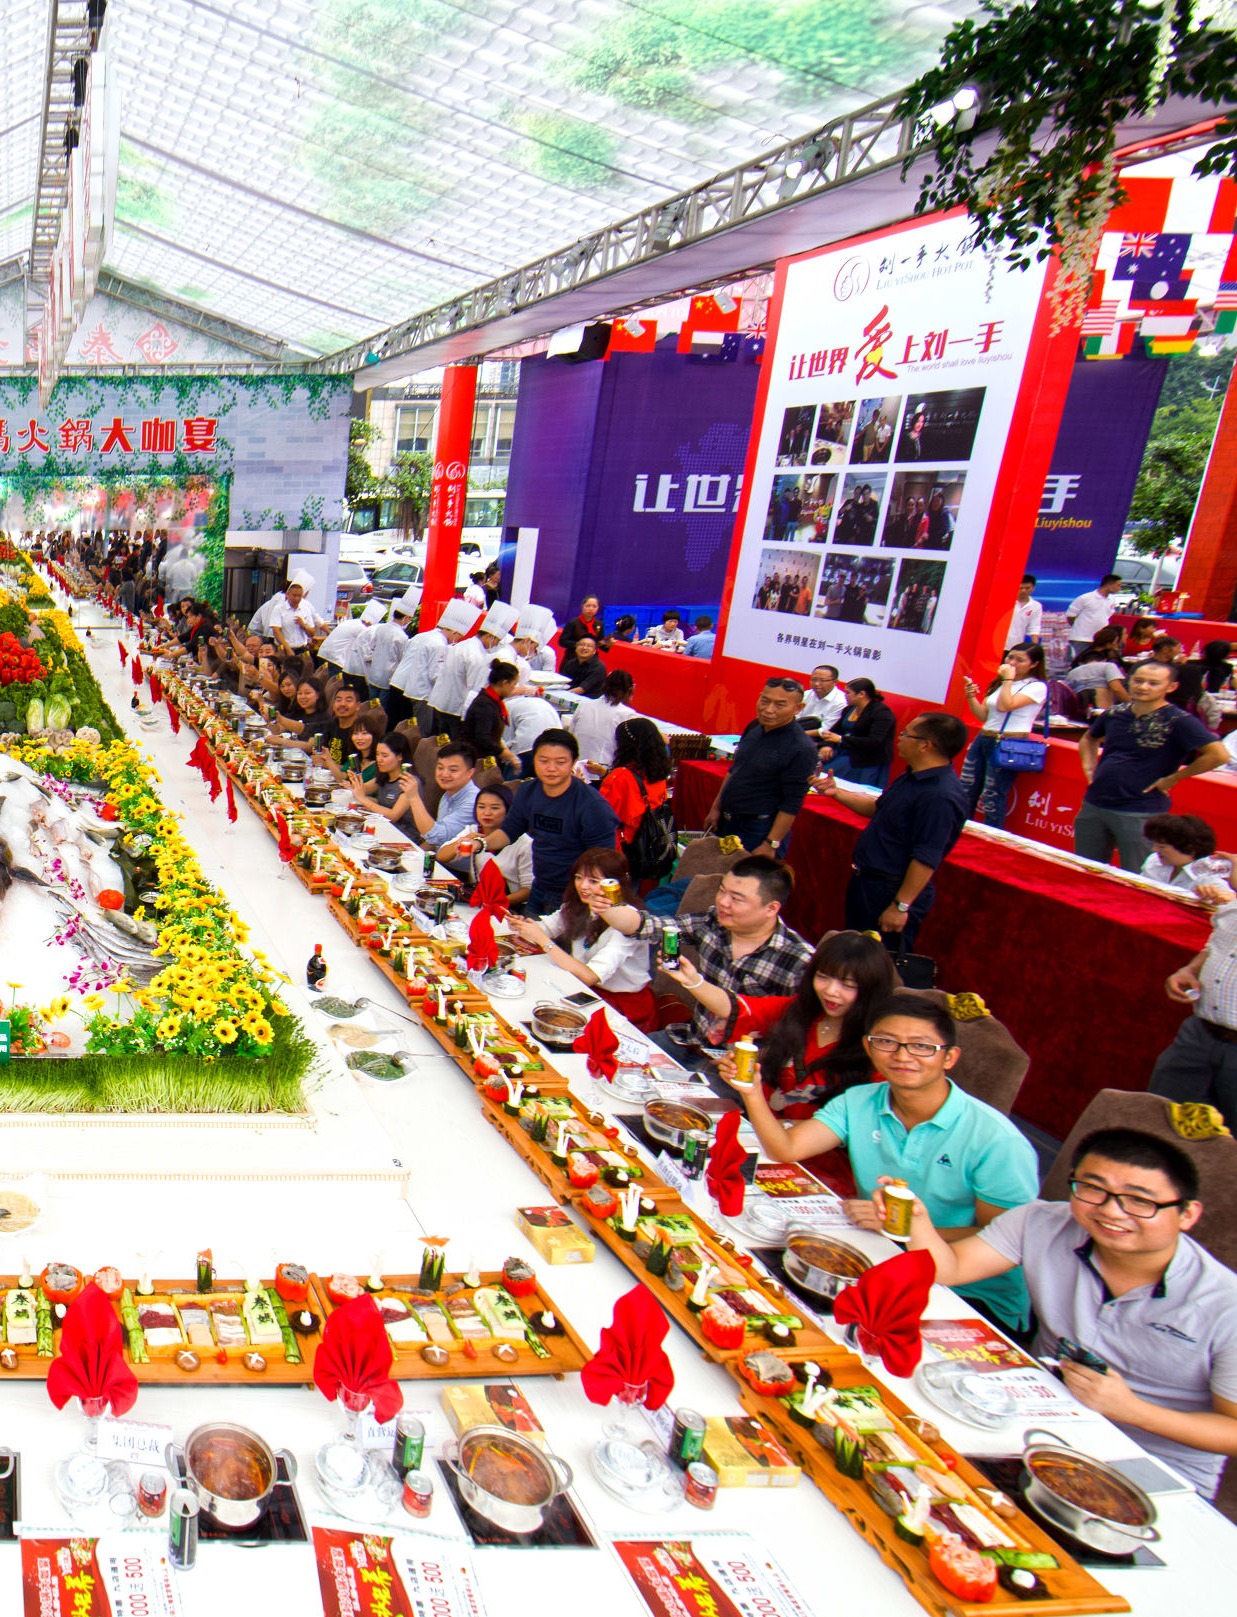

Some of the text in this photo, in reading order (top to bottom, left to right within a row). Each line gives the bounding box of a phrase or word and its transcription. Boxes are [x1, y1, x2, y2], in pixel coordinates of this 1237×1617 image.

[932, 265, 952, 278] HOT
[954, 259, 974, 272] POT
[922, 362, 941, 372] world
[632, 473, 746, 513] 让世
[1034, 516, 1093, 531] Liuyishou
[776, 632, 882, 661] 各界明星在刘一手火锅留影
[123, 1557, 144, 1579] 500
[421, 1561, 444, 1584] 500
[727, 1561, 756, 1583] 500
